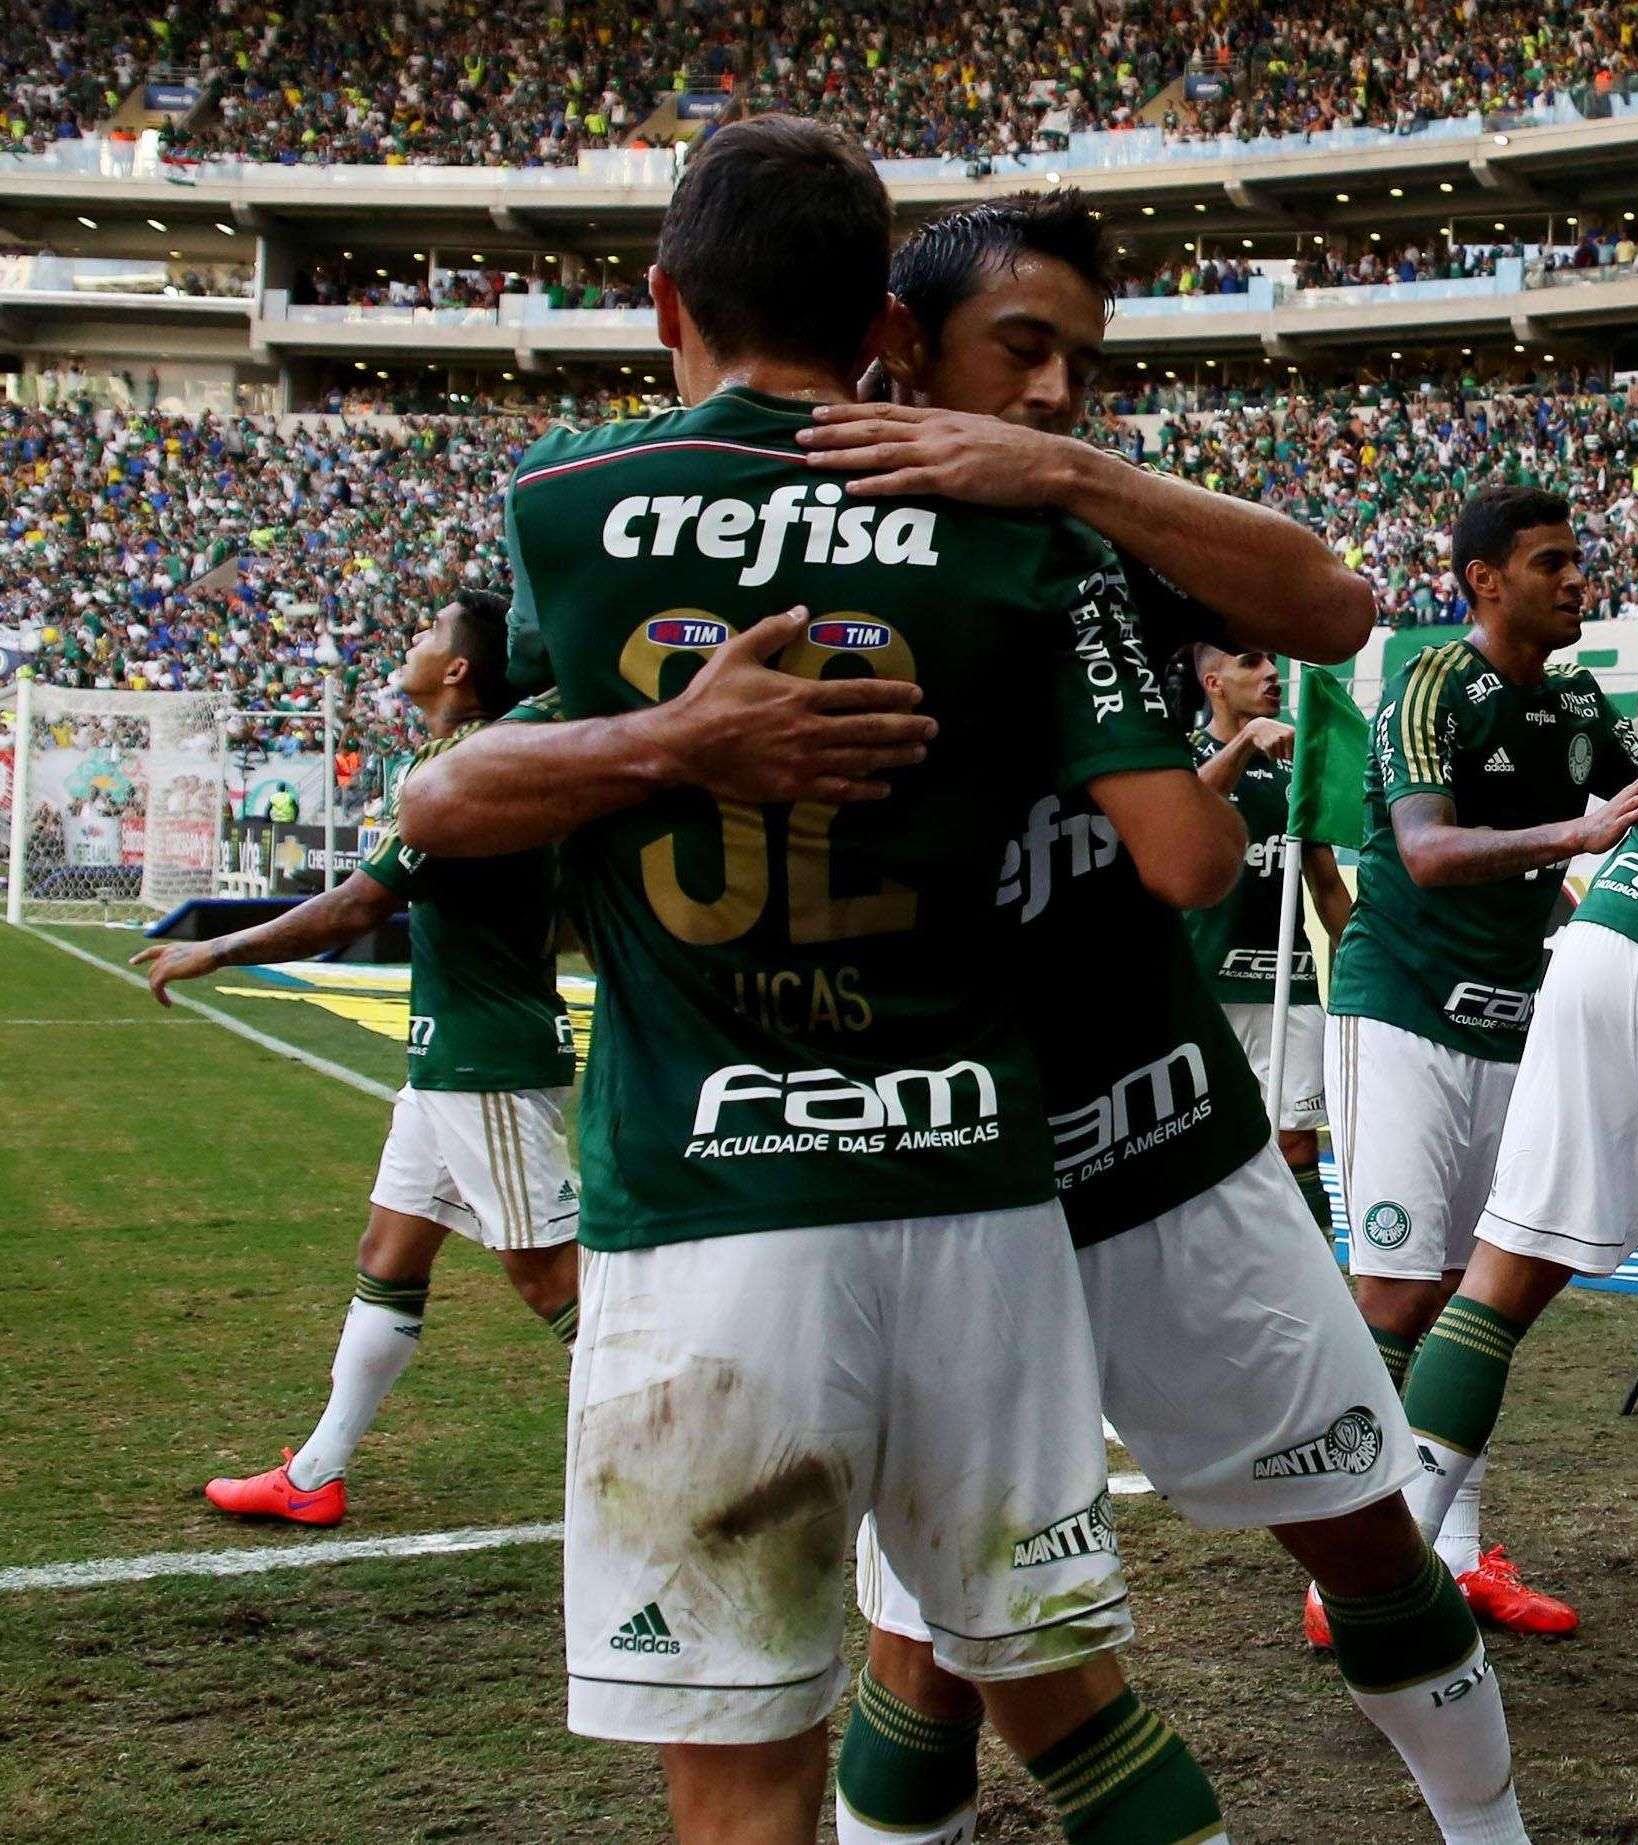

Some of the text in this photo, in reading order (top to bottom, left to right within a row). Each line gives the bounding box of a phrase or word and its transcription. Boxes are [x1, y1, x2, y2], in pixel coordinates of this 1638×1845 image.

[602, 483, 939, 587] crefisa
[683, 625, 719, 643] TIM
[846, 627, 881, 645] TIM
[1526, 709, 1556, 726] crefisa
[684, 1121, 1000, 1159] FACULDADE DAS AMÉRICAS
[1080, 1151, 1114, 1182] DAS
[1254, 1430, 1378, 1479] AVANTI PALMEIRAS
[1013, 1511, 1099, 1567] AVANTI
[610, 1633, 681, 1655] adidas
